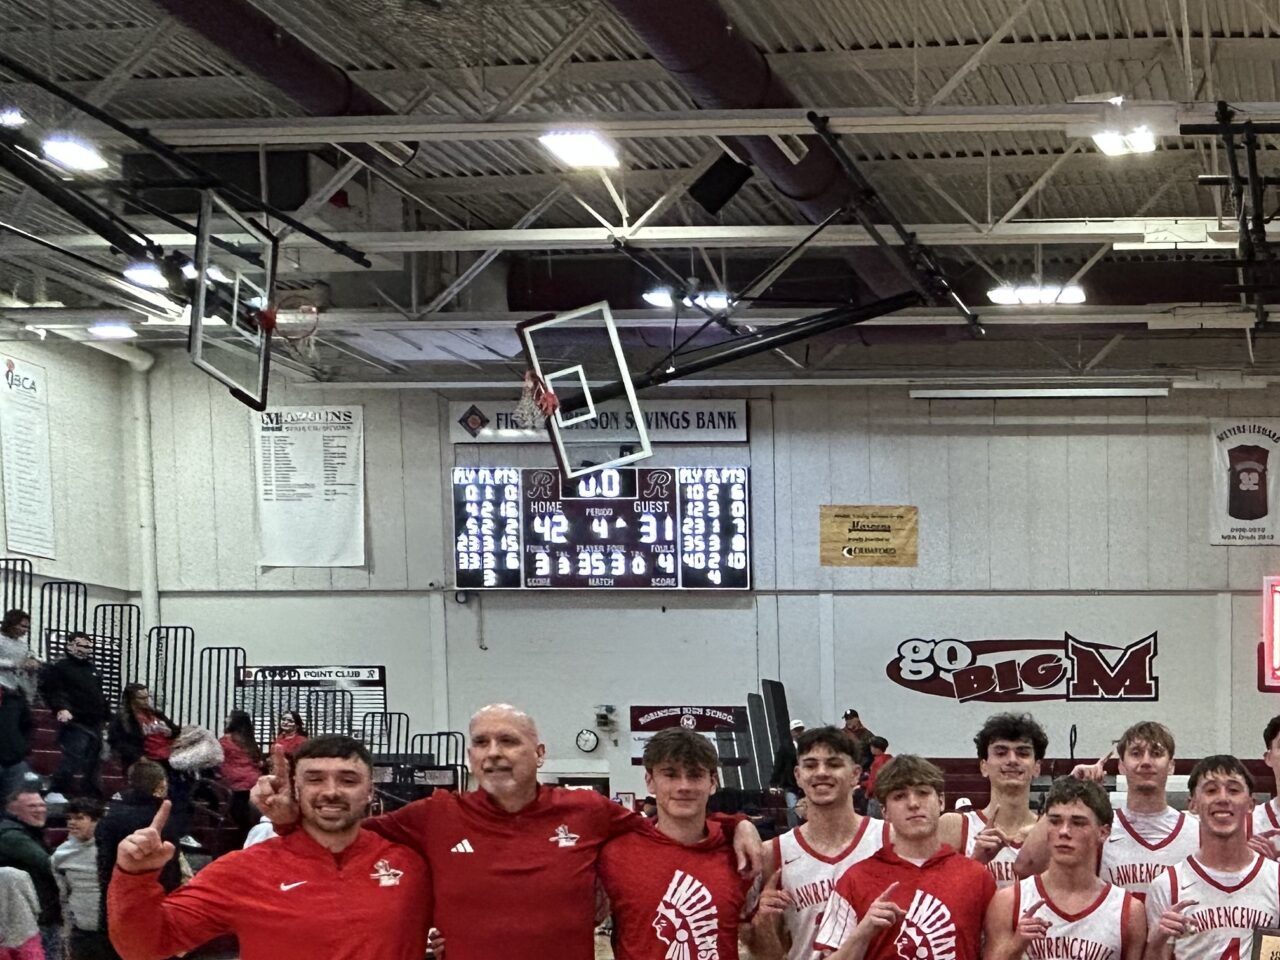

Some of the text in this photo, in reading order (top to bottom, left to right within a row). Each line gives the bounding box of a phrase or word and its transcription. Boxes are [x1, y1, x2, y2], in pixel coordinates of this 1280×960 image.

[625, 411, 690, 429] SVINGS
[696, 411, 737, 429] BANK
[643, 470, 671, 498] R
[706, 484, 719, 500] 2
[731, 484, 744, 500] 6
[531, 502, 562, 513] HOME
[586, 508, 613, 516] PERIOD
[634, 501, 669, 513] GUEST
[707, 501, 720, 518] 3
[731, 501, 745, 517] 0
[481, 518, 493, 535] 2
[505, 519, 518, 534] 2
[533, 515, 569, 543] 42
[592, 517, 608, 539] 4
[638, 513, 674, 544] 31
[682, 518, 705, 534] 23
[501, 535, 518, 552] 15
[651, 545, 675, 553] FOULS
[683, 535, 705, 552] 35
[708, 535, 720, 551] 3
[506, 553, 519, 569] 6
[535, 552, 550, 575] 3
[578, 552, 626, 576] 35 3
[631, 556, 646, 574] 0
[658, 553, 674, 573] 4
[683, 552, 745, 569] 40 2 10
[483, 569, 496, 586] 3
[527, 578, 551, 586] SCORE
[588, 578, 614, 586] MATCH
[651, 578, 676, 586] SCORE
[707, 570, 721, 585] 4
[1064, 631, 1159, 702] M
[952, 653, 1066, 702] BIG
[1108, 862, 1169, 886] LAWRENC
